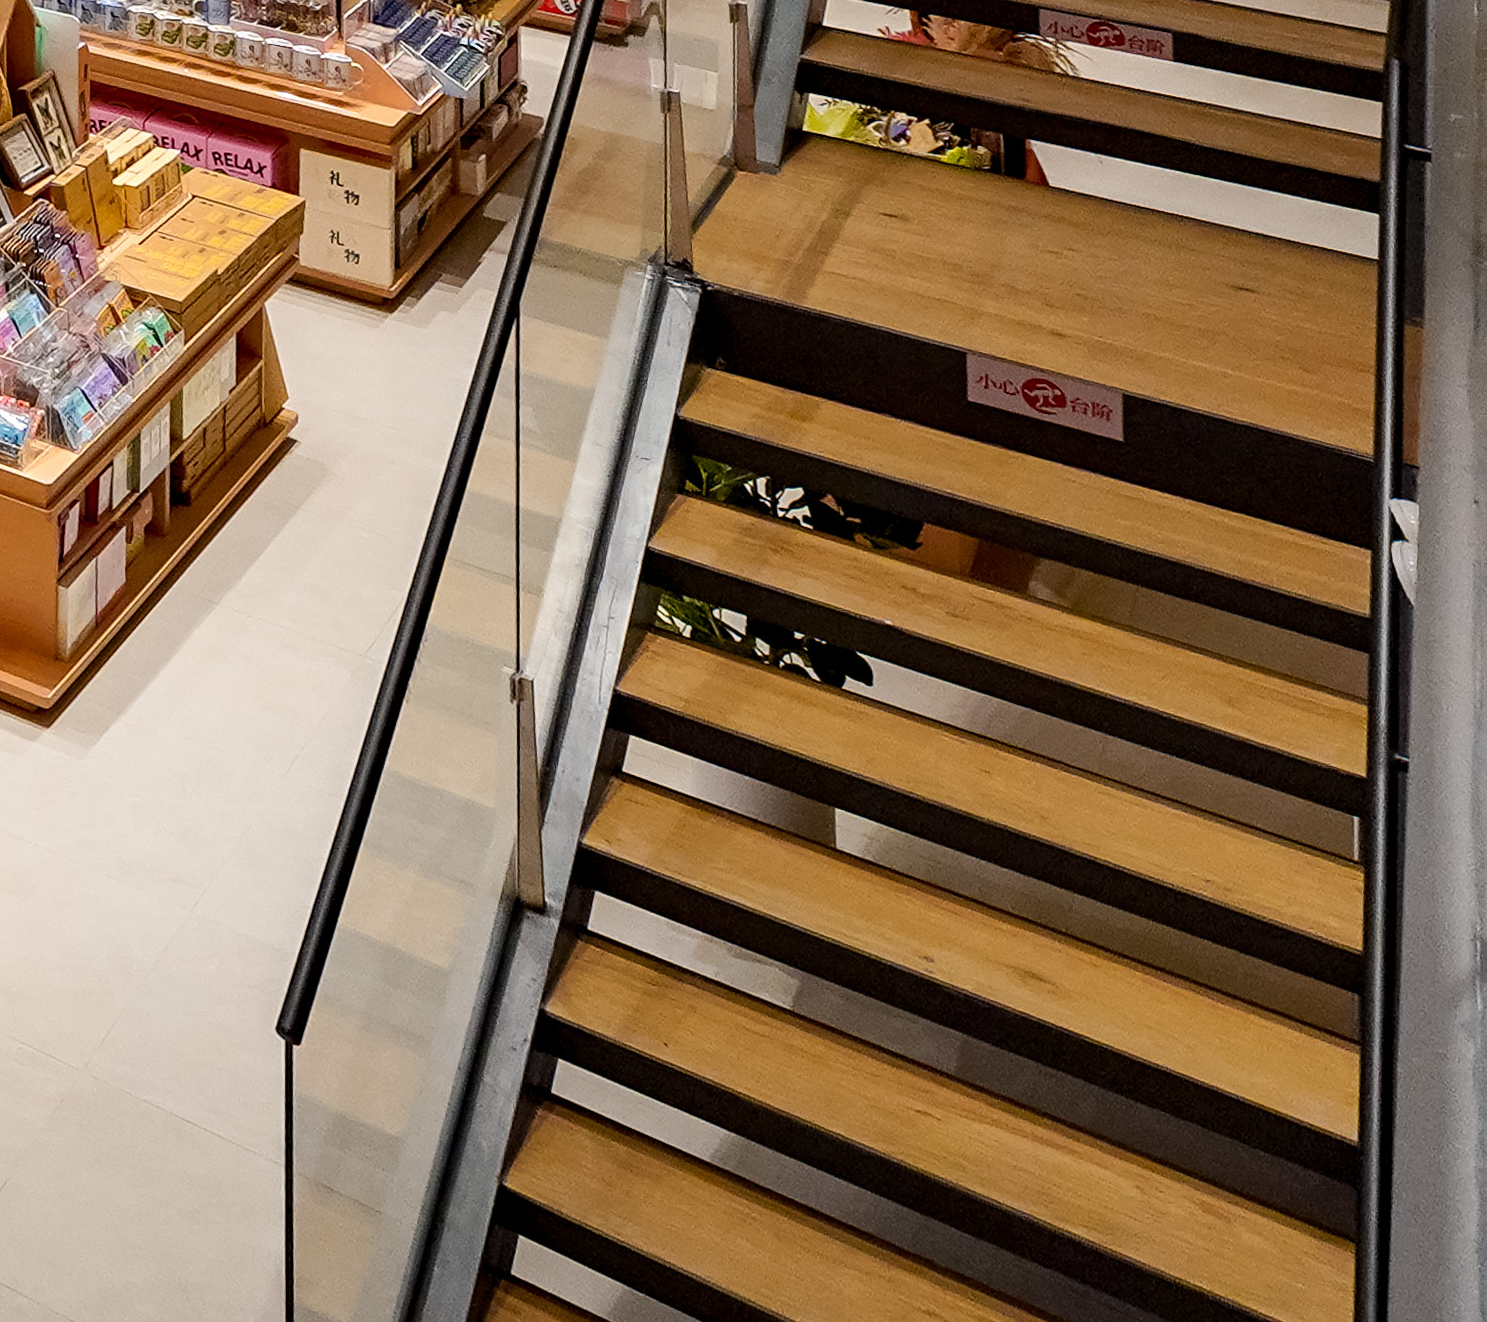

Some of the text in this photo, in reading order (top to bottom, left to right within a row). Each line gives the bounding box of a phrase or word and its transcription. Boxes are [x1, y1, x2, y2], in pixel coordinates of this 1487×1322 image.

[1046, 20, 1166, 55] 小心 台阶
[151, 132, 204, 161] RELAX
[209, 149, 270, 176] RELAX
[973, 371, 1115, 422] 小心 台阶
